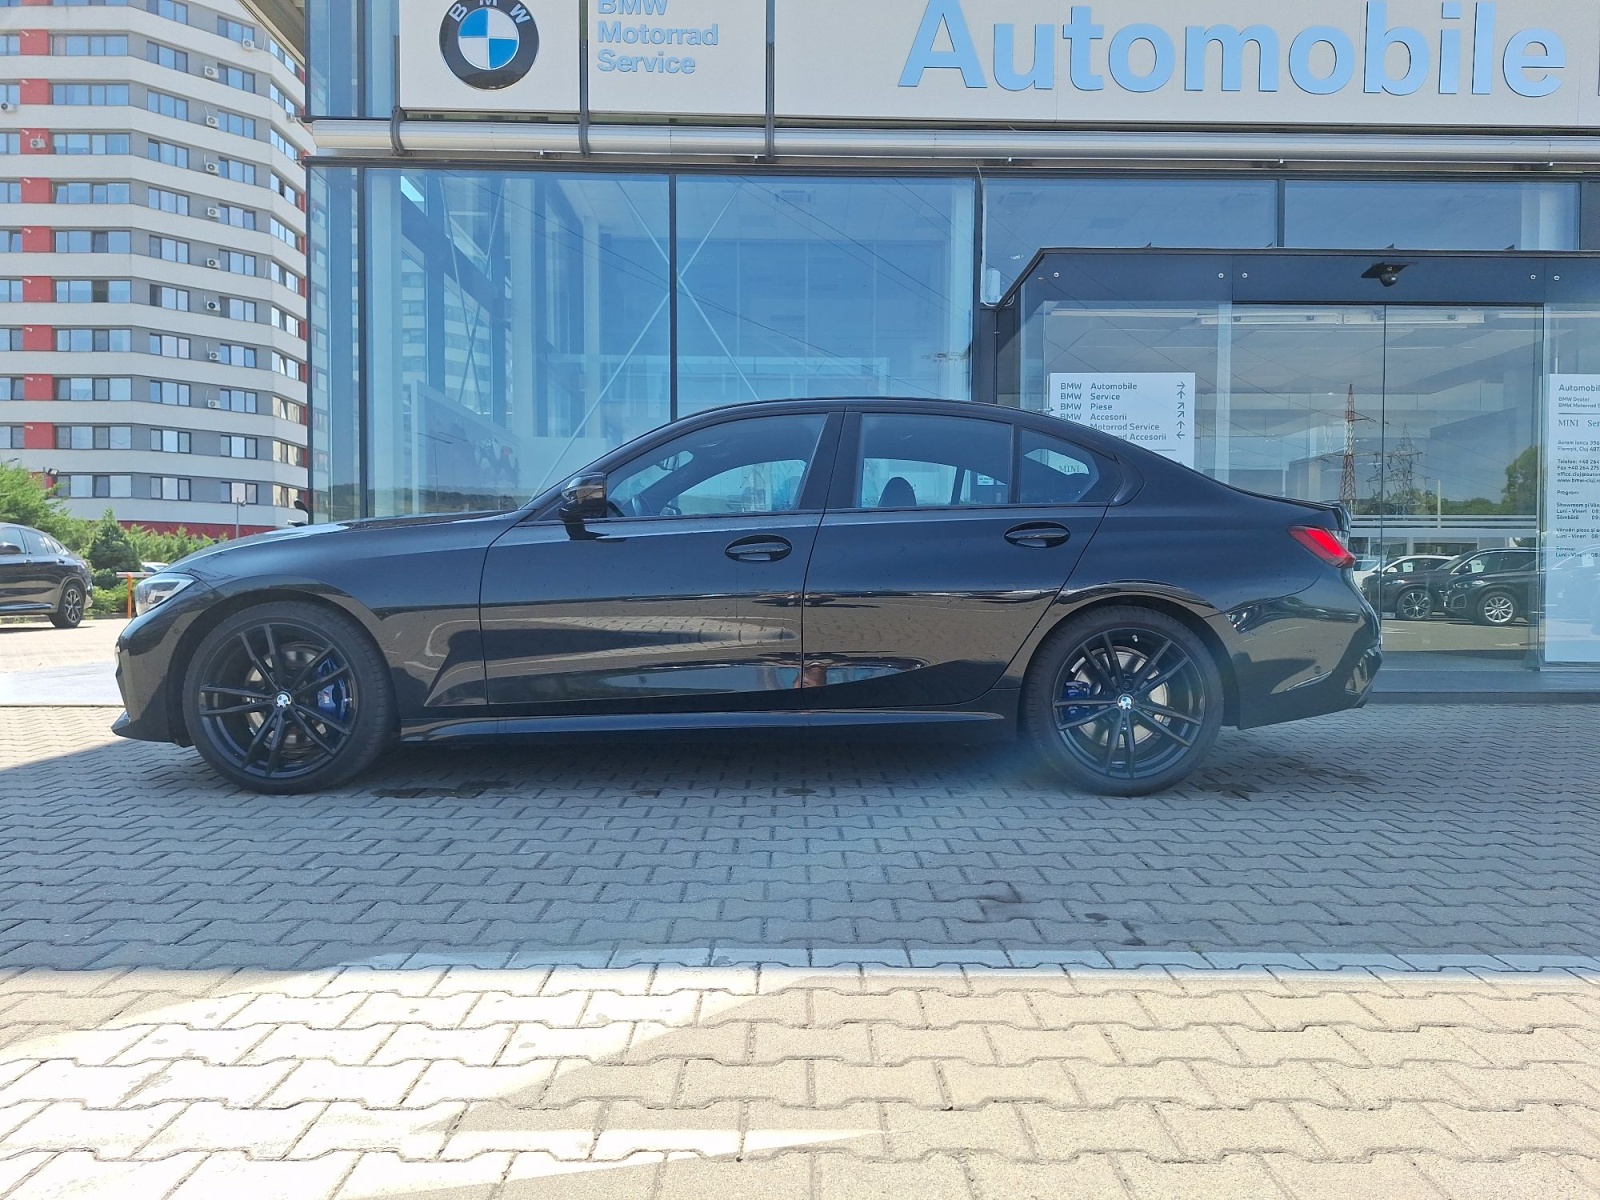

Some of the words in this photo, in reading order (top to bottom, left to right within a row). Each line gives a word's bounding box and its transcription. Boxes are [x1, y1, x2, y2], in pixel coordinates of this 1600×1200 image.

[597, 0, 667, 15] BMW
[598, 21, 719, 46] Motorrad
[898, 0, 1566, 97] Automobile
[597, 49, 696, 74] Service
[1060, 382, 1082, 390] BMW
[1090, 382, 1138, 390] Automobile
[1558, 384, 1600, 392] Automobil
[1558, 419, 1579, 427] MINI
